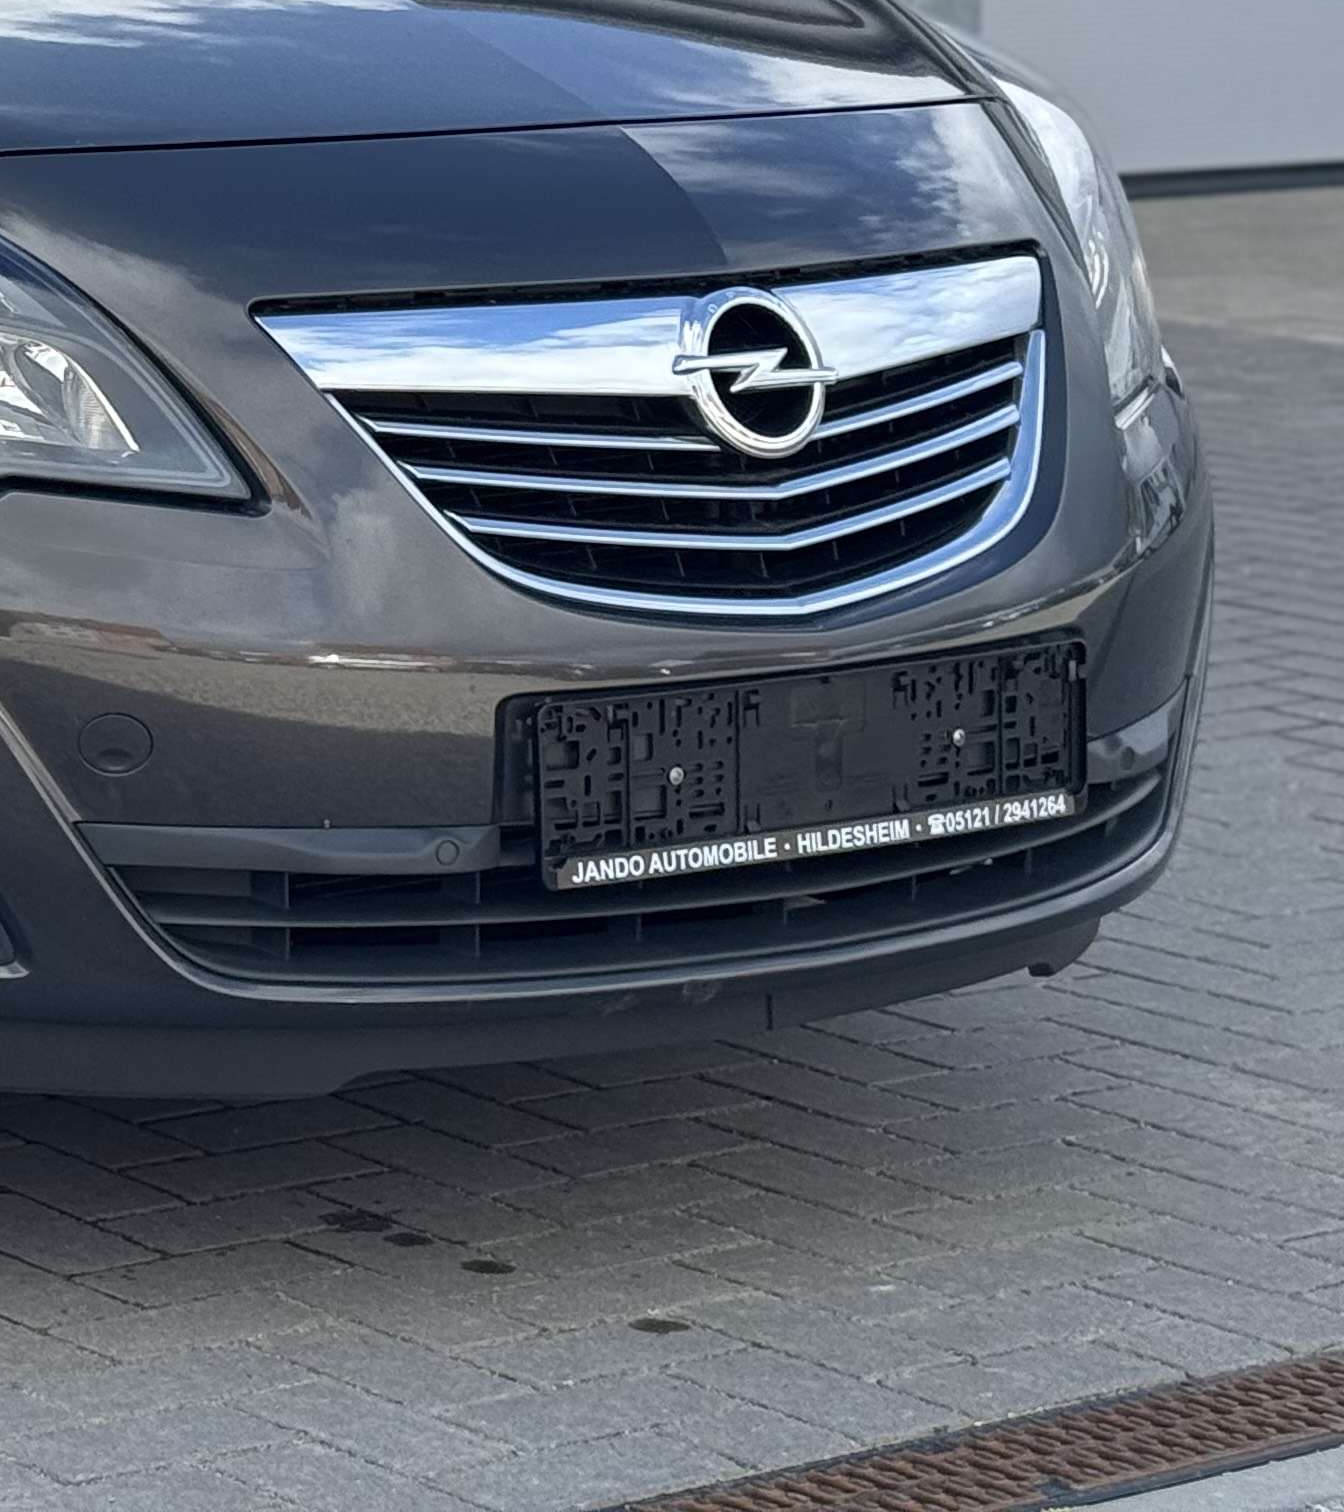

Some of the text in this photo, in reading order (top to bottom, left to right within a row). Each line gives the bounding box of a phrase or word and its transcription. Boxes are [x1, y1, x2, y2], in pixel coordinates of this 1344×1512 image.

[571, 855, 645, 884] JANDO
[648, 837, 778, 875] AUTOMOBILE
[796, 818, 911, 854] HILDESHEIM
[1003, 794, 1067, 824] 2941264
